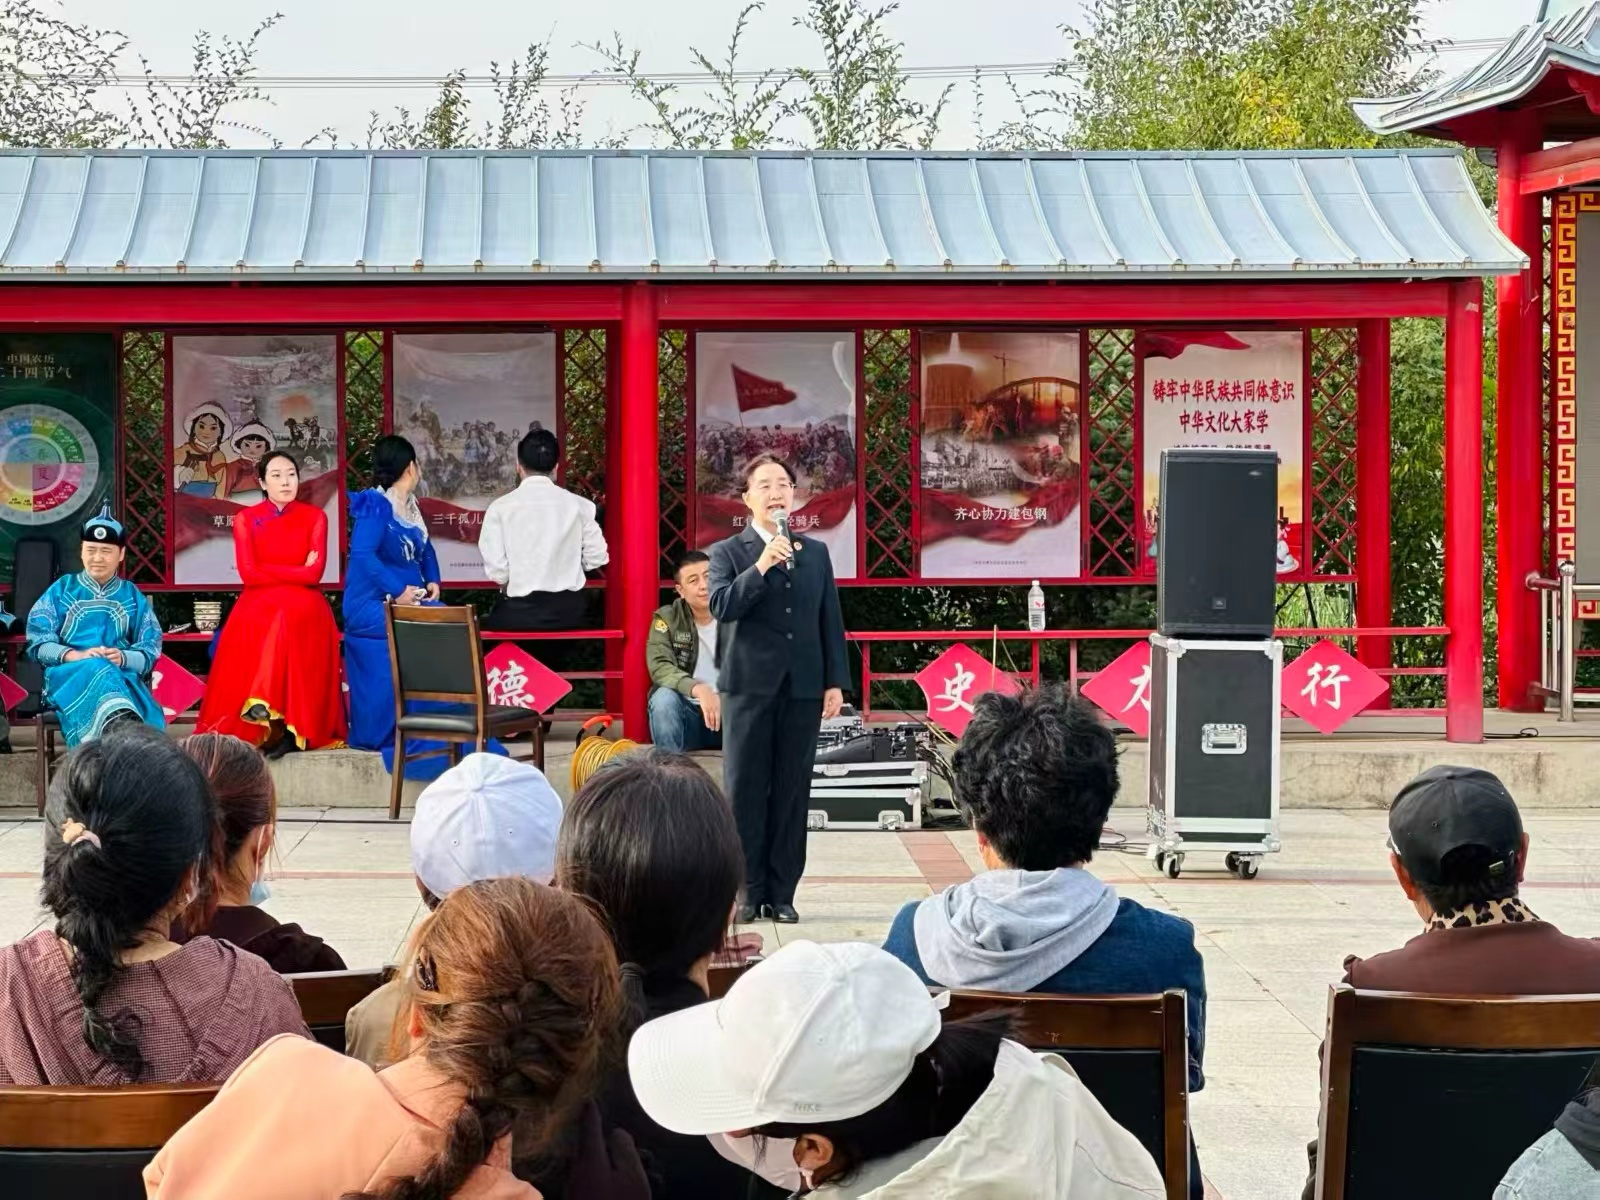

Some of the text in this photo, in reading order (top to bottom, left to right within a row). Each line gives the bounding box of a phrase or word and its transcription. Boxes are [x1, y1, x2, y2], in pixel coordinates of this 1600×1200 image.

[1153, 378, 1295, 403] 铸牢中华民族共同体意识
[1179, 409, 1269, 433] 中华文化大家学
[431, 512, 483, 525] 三千孤儿
[954, 507, 1047, 520] 齐心协力建包钢
[1300, 662, 1351, 710] 行
